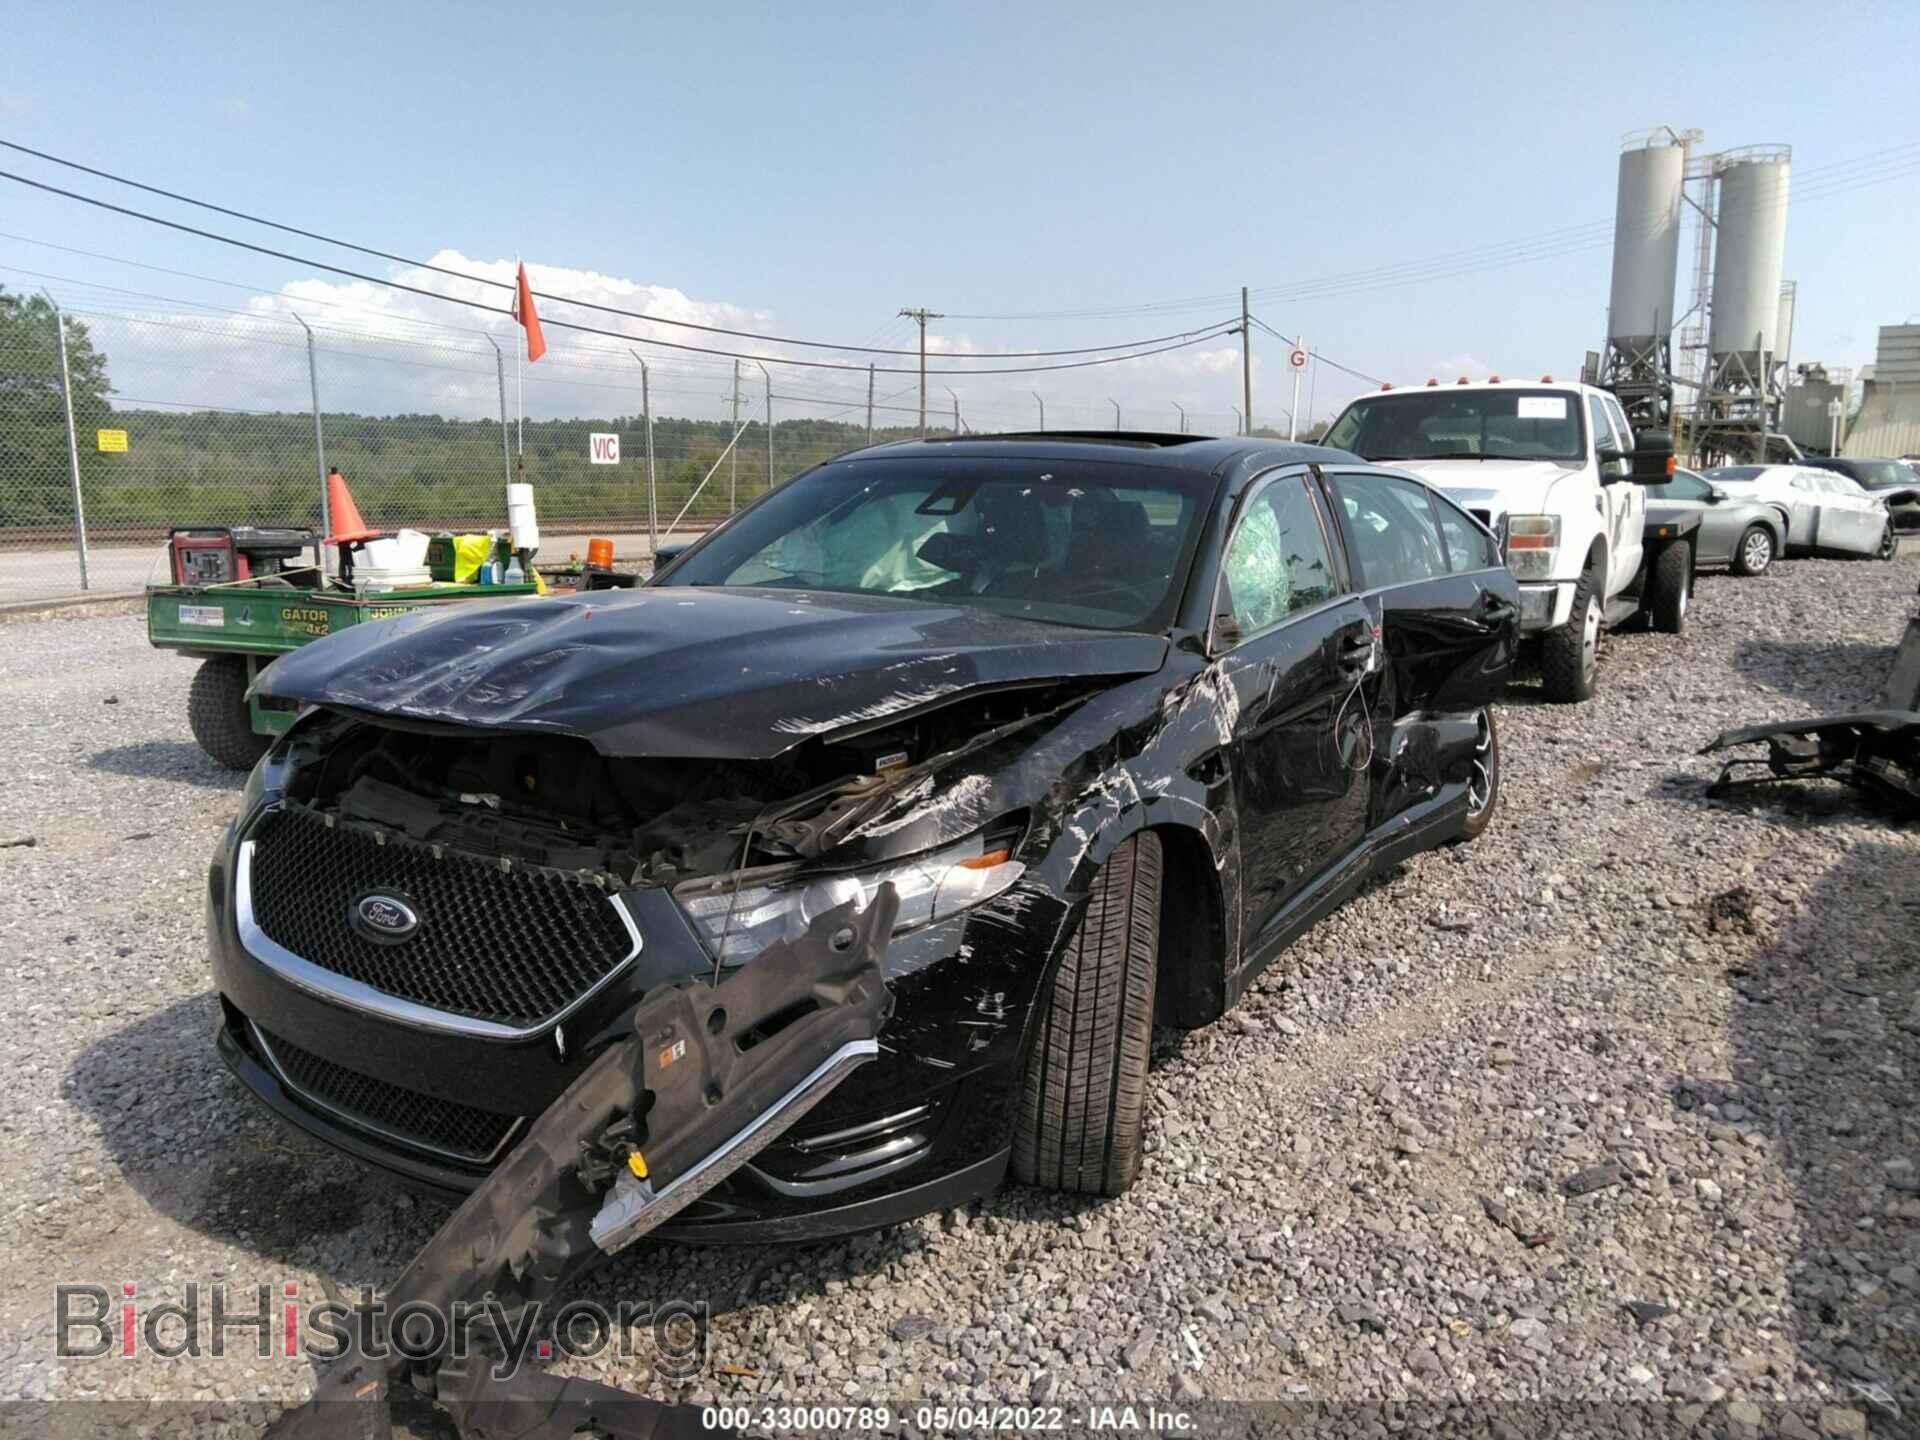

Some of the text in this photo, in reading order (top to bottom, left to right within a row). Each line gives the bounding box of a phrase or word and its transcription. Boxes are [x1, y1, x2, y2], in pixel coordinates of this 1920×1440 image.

[1291, 351, 1304, 366] G
[593, 437, 616, 460] VIC
[282, 609, 328, 621] GATOR
[368, 902, 400, 926] Ford
